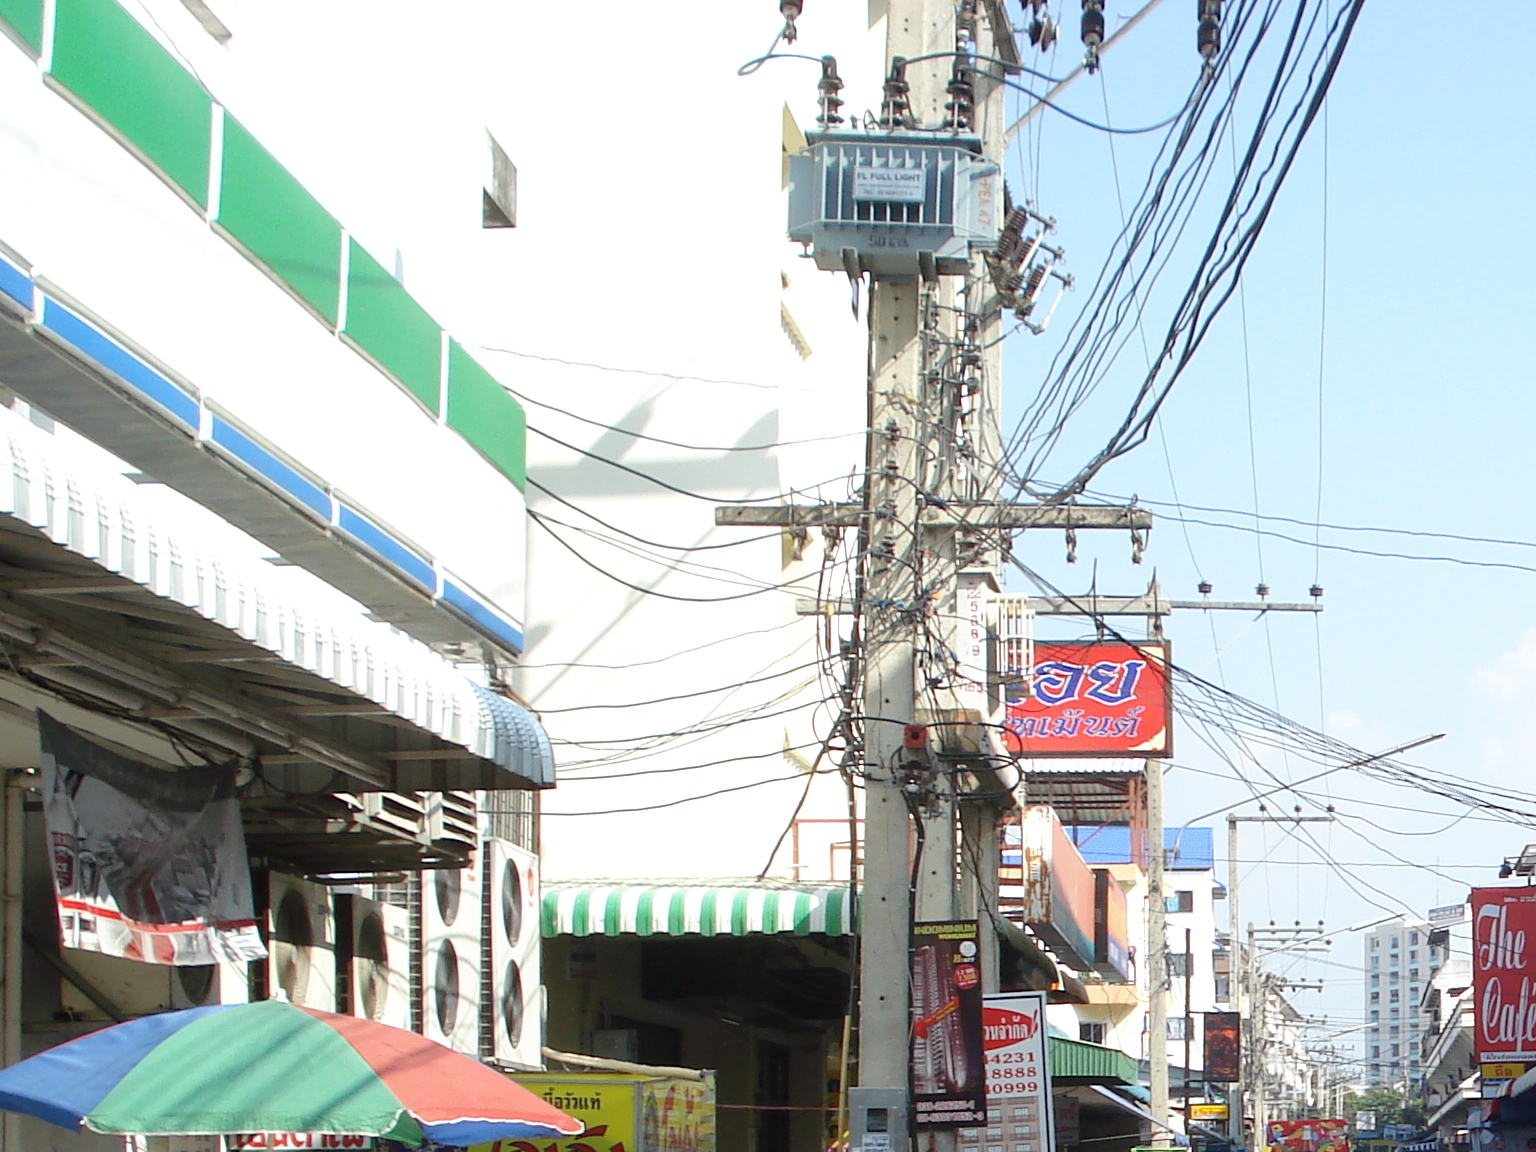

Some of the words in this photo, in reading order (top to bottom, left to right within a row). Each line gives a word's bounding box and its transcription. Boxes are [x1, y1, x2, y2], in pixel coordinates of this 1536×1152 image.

[870, 173, 892, 182] FULL
[894, 174, 921, 183] LIGHT
[1476, 903, 1527, 970] The
[985, 1066, 1037, 1079] 8888
